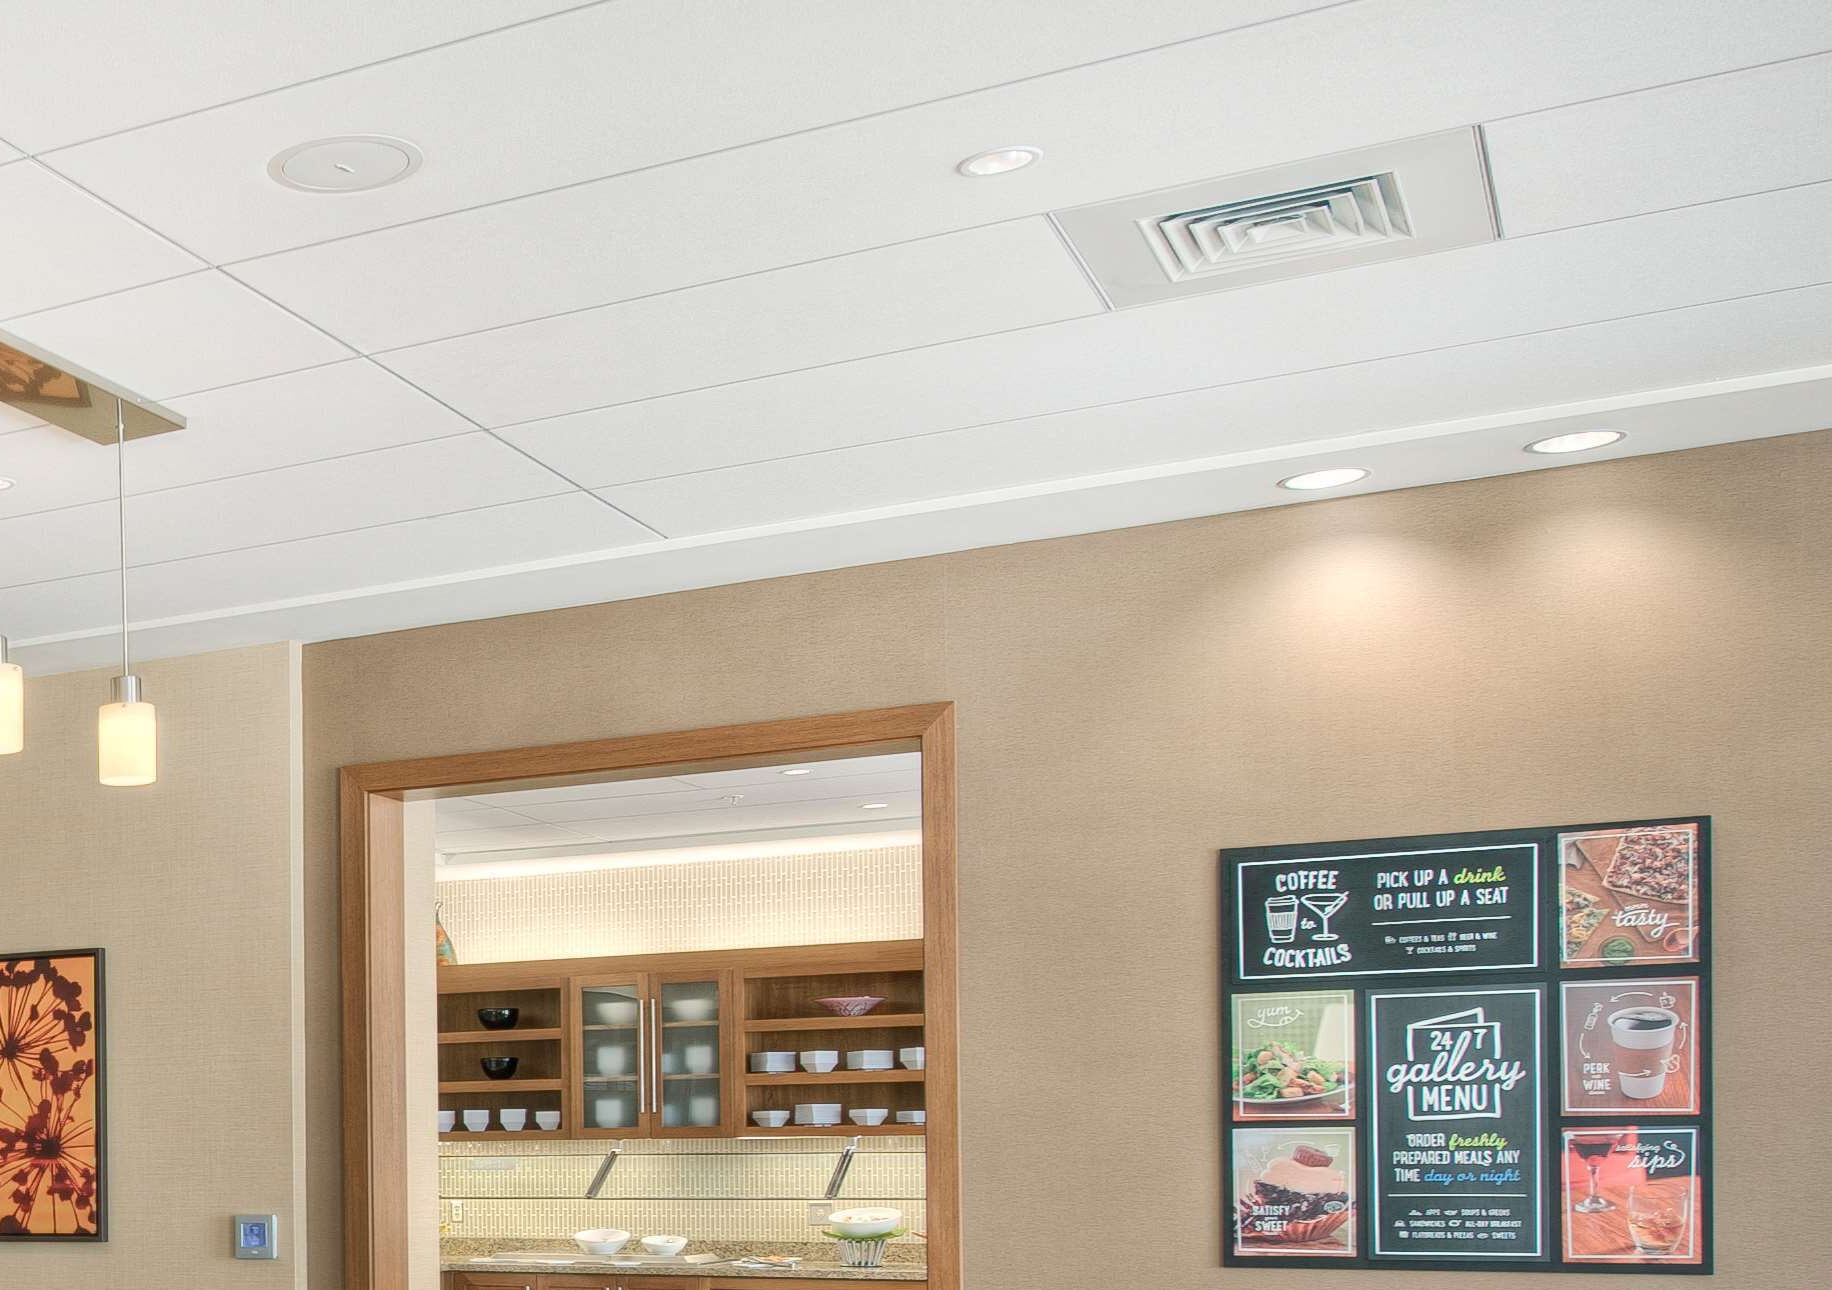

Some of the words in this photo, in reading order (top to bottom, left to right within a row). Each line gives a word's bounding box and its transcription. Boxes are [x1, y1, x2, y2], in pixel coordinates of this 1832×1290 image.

[1275, 870, 1339, 893] COFFEE
[1376, 870, 1409, 888] PICK
[1414, 869, 1433, 886] UP
[1438, 868, 1448, 885] A
[1453, 866, 1506, 885] drink
[1373, 893, 1393, 911] OR
[1398, 892, 1430, 910] PULL
[1436, 890, 1455, 907] UP
[1460, 889, 1470, 905] A
[1476, 886, 1509, 905] SEAT
[1301, 917, 1318, 930] to
[1611, 909, 1680, 938] tasty
[1263, 944, 1352, 968] COCKTAILS
[1386, 1031, 1527, 1093] gallery
[1583, 1062, 1610, 1074] PERK
[1583, 1079, 1611, 1090] WINE
[1422, 1084, 1488, 1112] MENU
[1406, 1133, 1446, 1147] ORDER
[1448, 1133, 1508, 1151] freshly
[1392, 1151, 1450, 1165] PREPARED
[1454, 1150, 1493, 1166] MEALS
[1496, 1150, 1520, 1164] ANY
[1627, 1150, 1685, 1174] sips
[1394, 1168, 1420, 1182] TIME
[1424, 1169, 1454, 1185] day
[1456, 1172, 1477, 1182] or
[1480, 1169, 1521, 1185] night
[1252, 1205, 1290, 1216] SATISFY
[1255, 1220, 1288, 1232] SWEET
